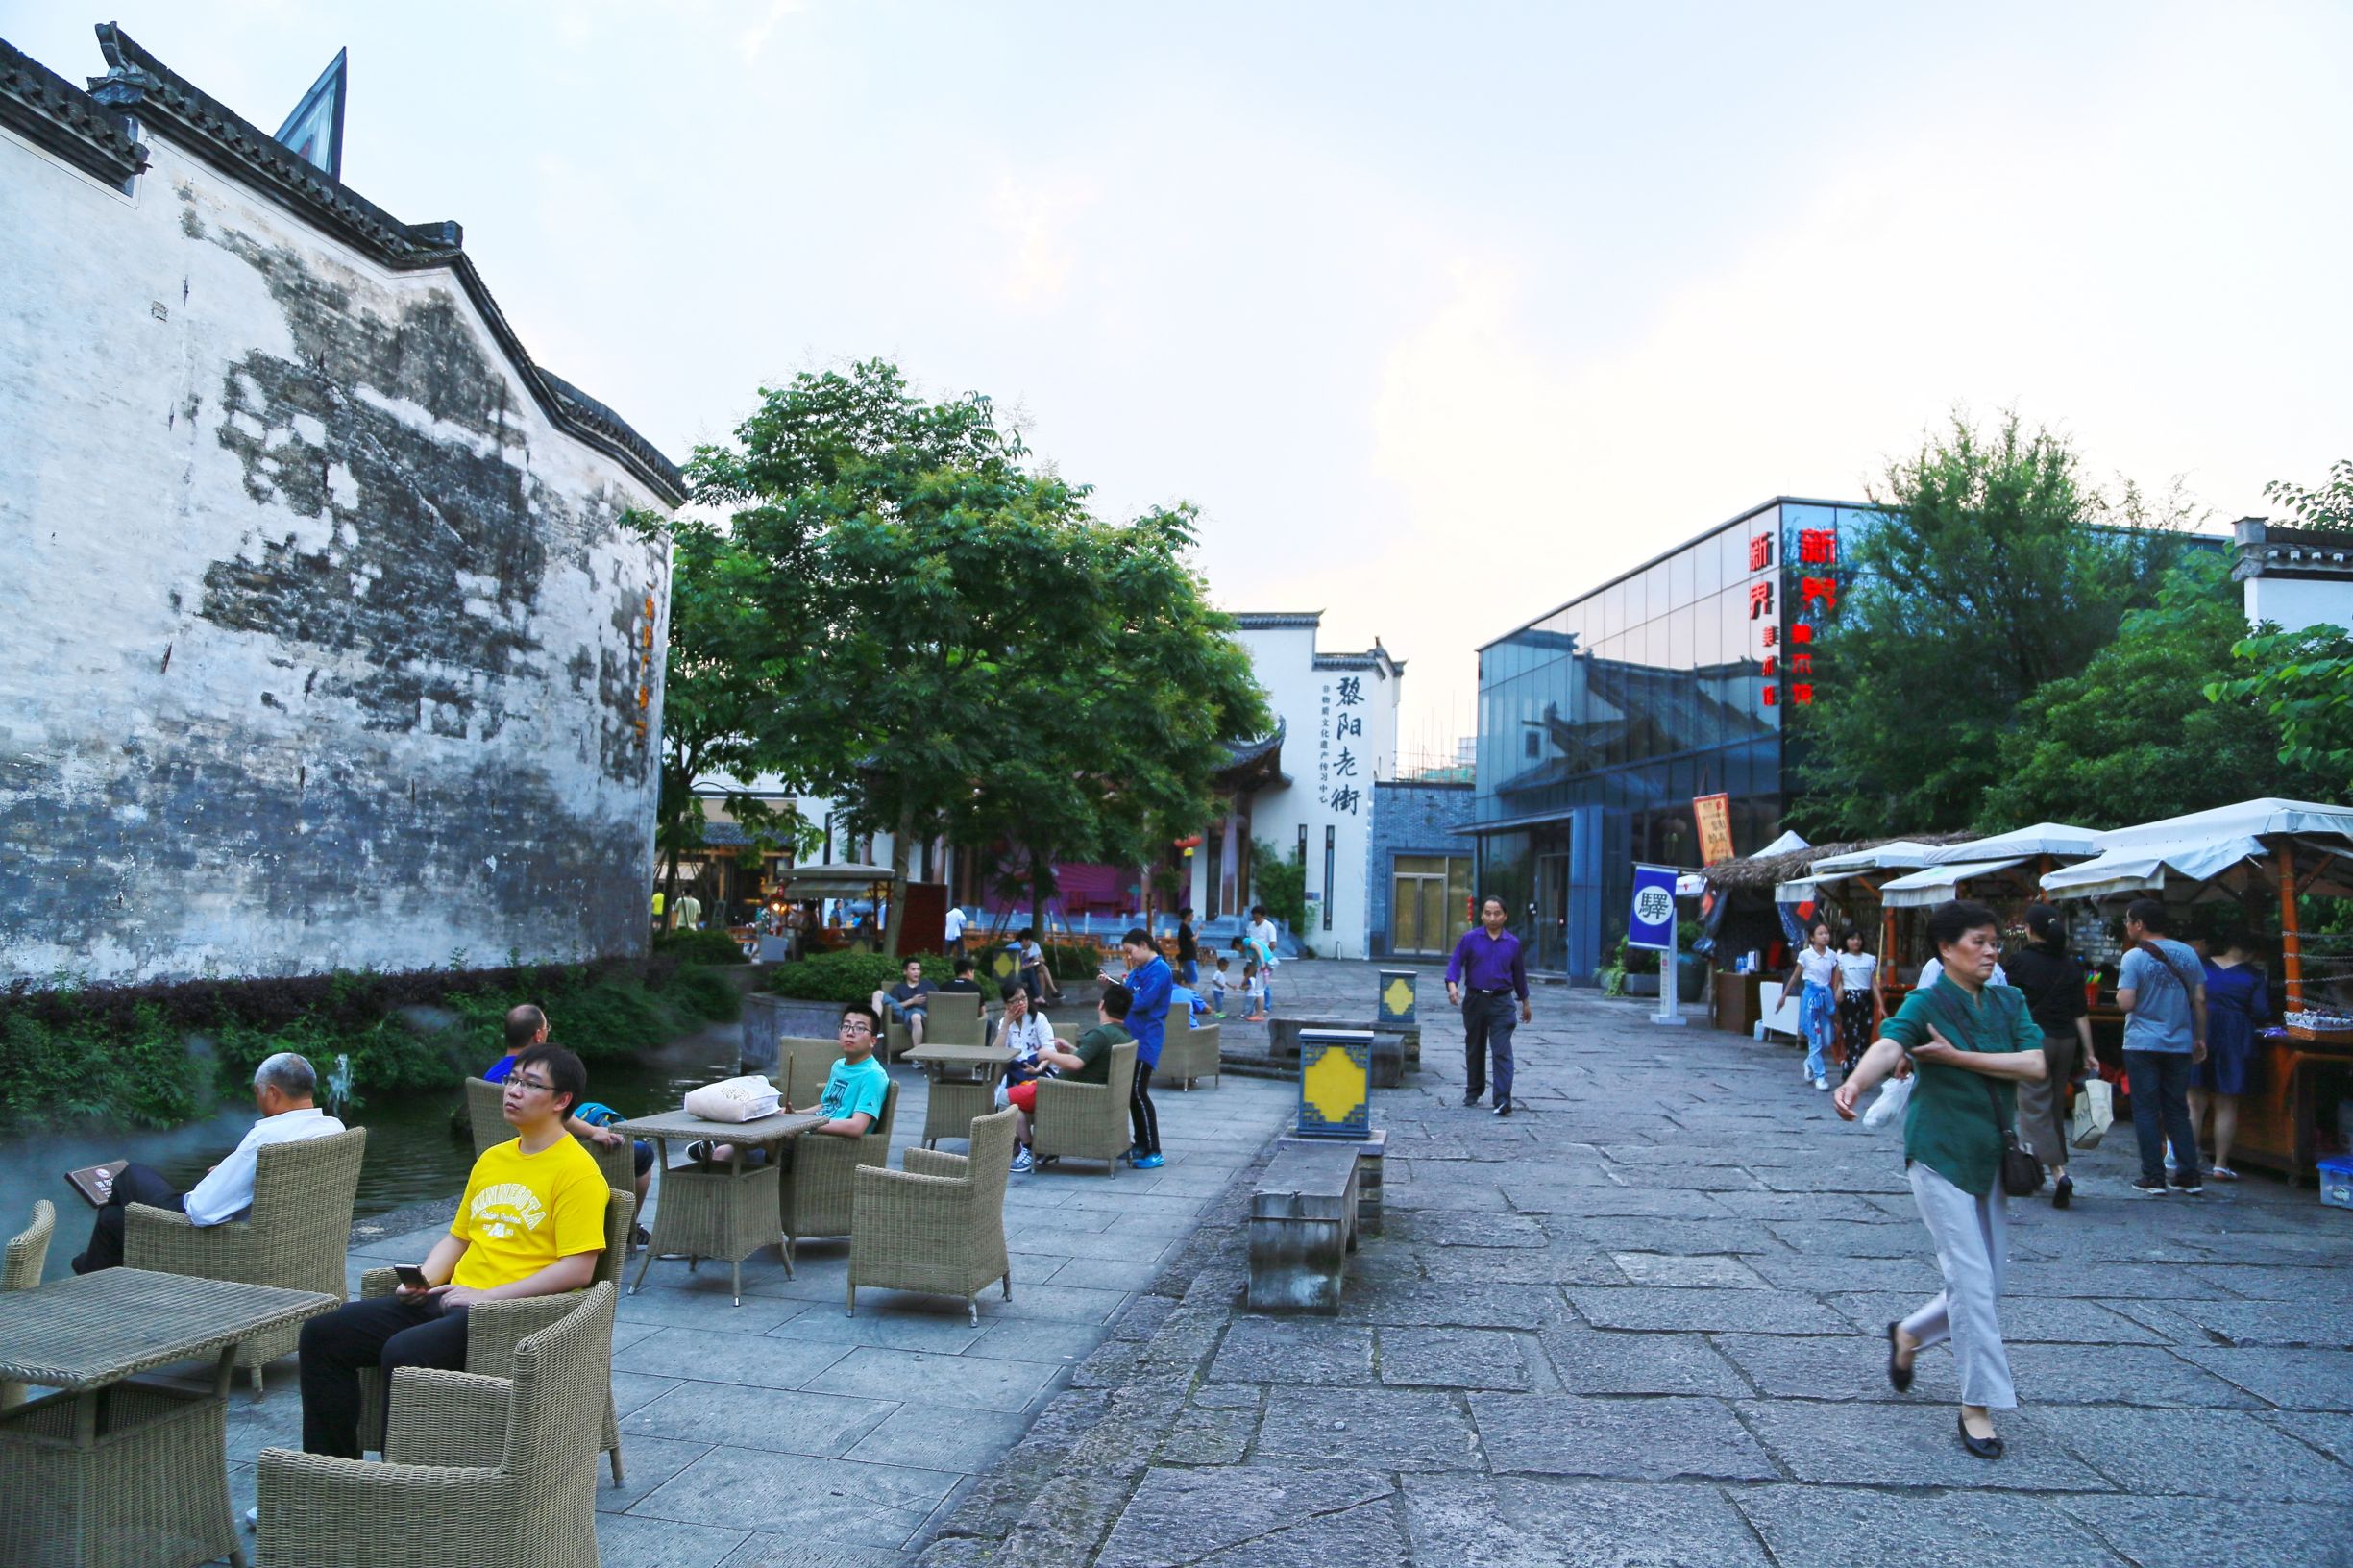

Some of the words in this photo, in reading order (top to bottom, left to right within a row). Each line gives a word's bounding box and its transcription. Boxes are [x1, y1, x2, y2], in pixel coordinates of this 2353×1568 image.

[1750, 531, 1770, 620] 新界
[1800, 528, 1837, 612] 新界
[471, 1183, 546, 1231] MINNESOTA
